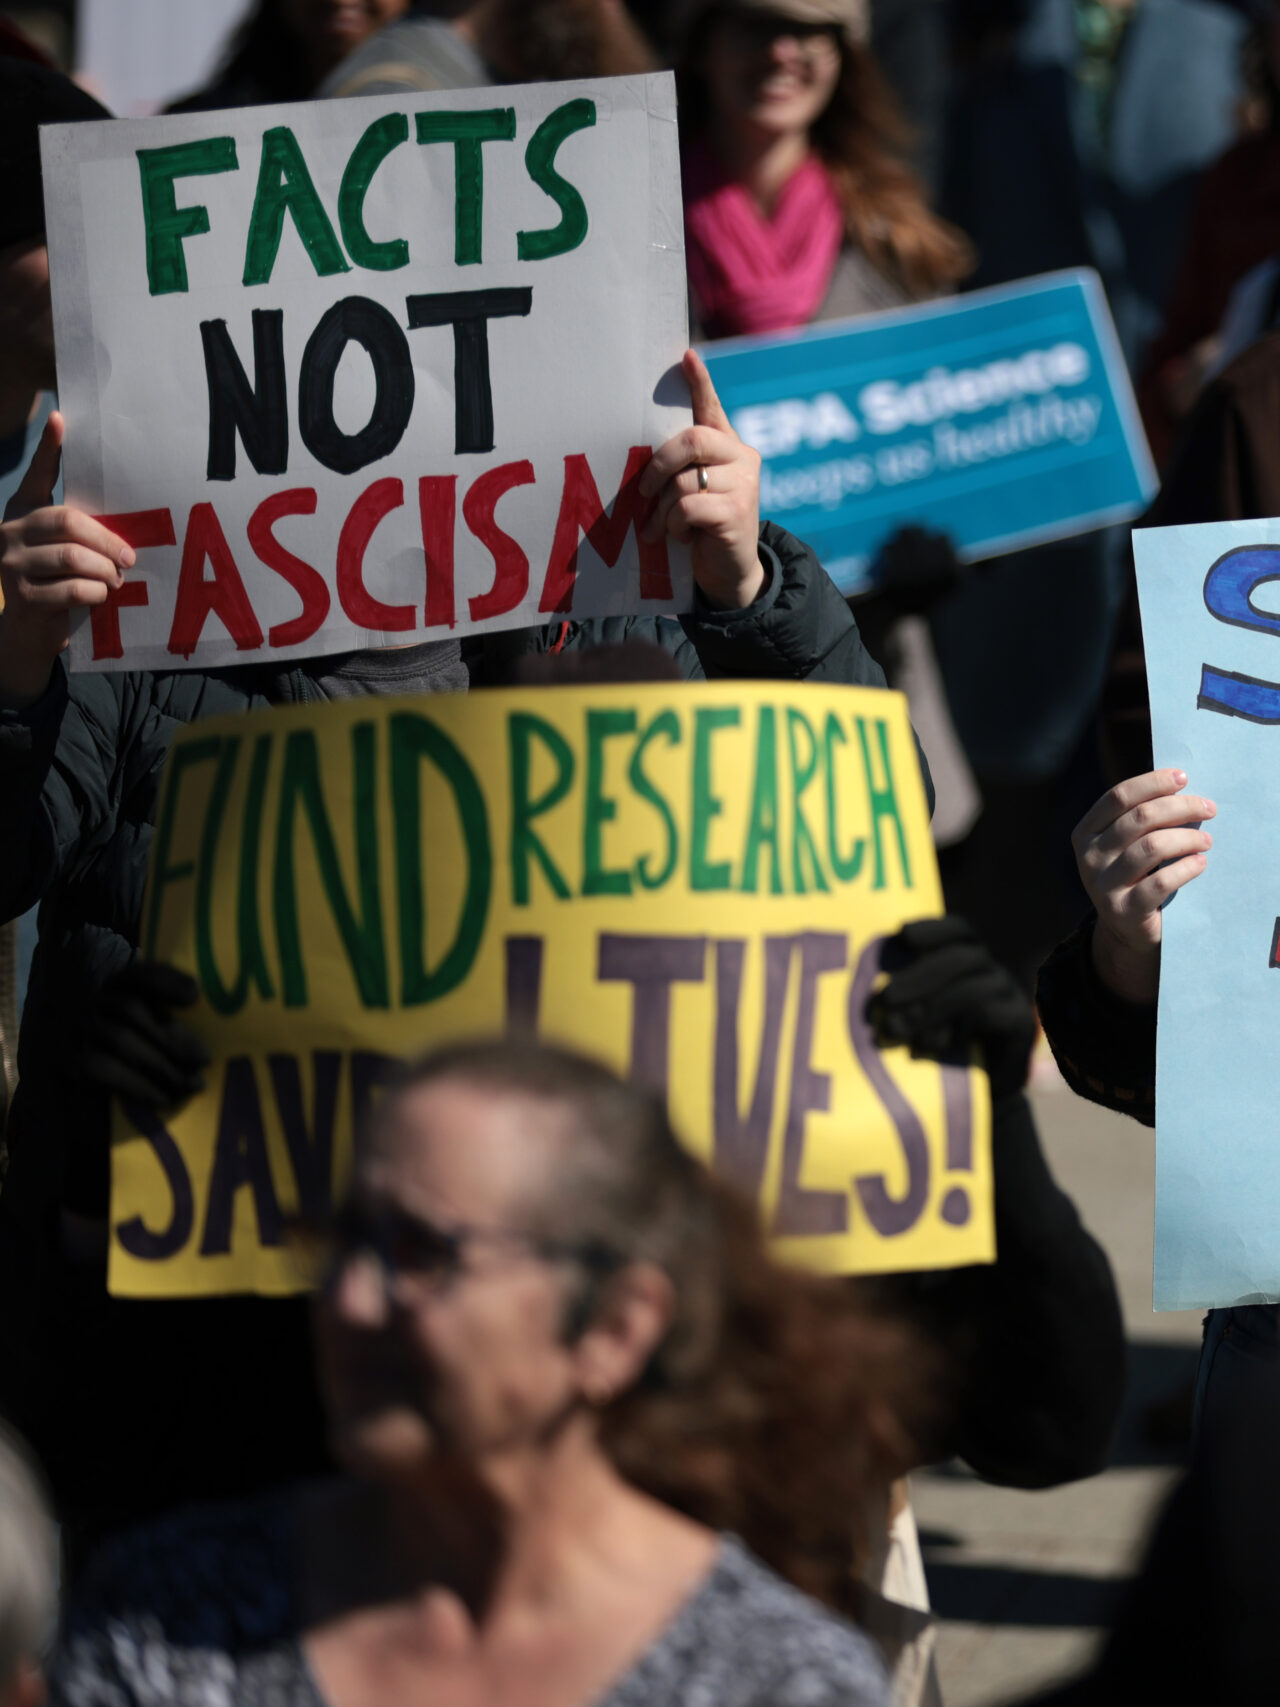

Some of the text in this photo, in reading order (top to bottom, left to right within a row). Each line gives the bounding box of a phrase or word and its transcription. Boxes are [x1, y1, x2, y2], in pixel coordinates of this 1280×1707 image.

[136, 98, 596, 295] FACTS
[200, 286, 533, 481] NOT
[735, 344, 1086, 457] EPA Science
[88, 446, 674, 660] FASCISM
[146, 704, 914, 1016] FUND RESEARCH
[114, 1048, 412, 1263] SAV
